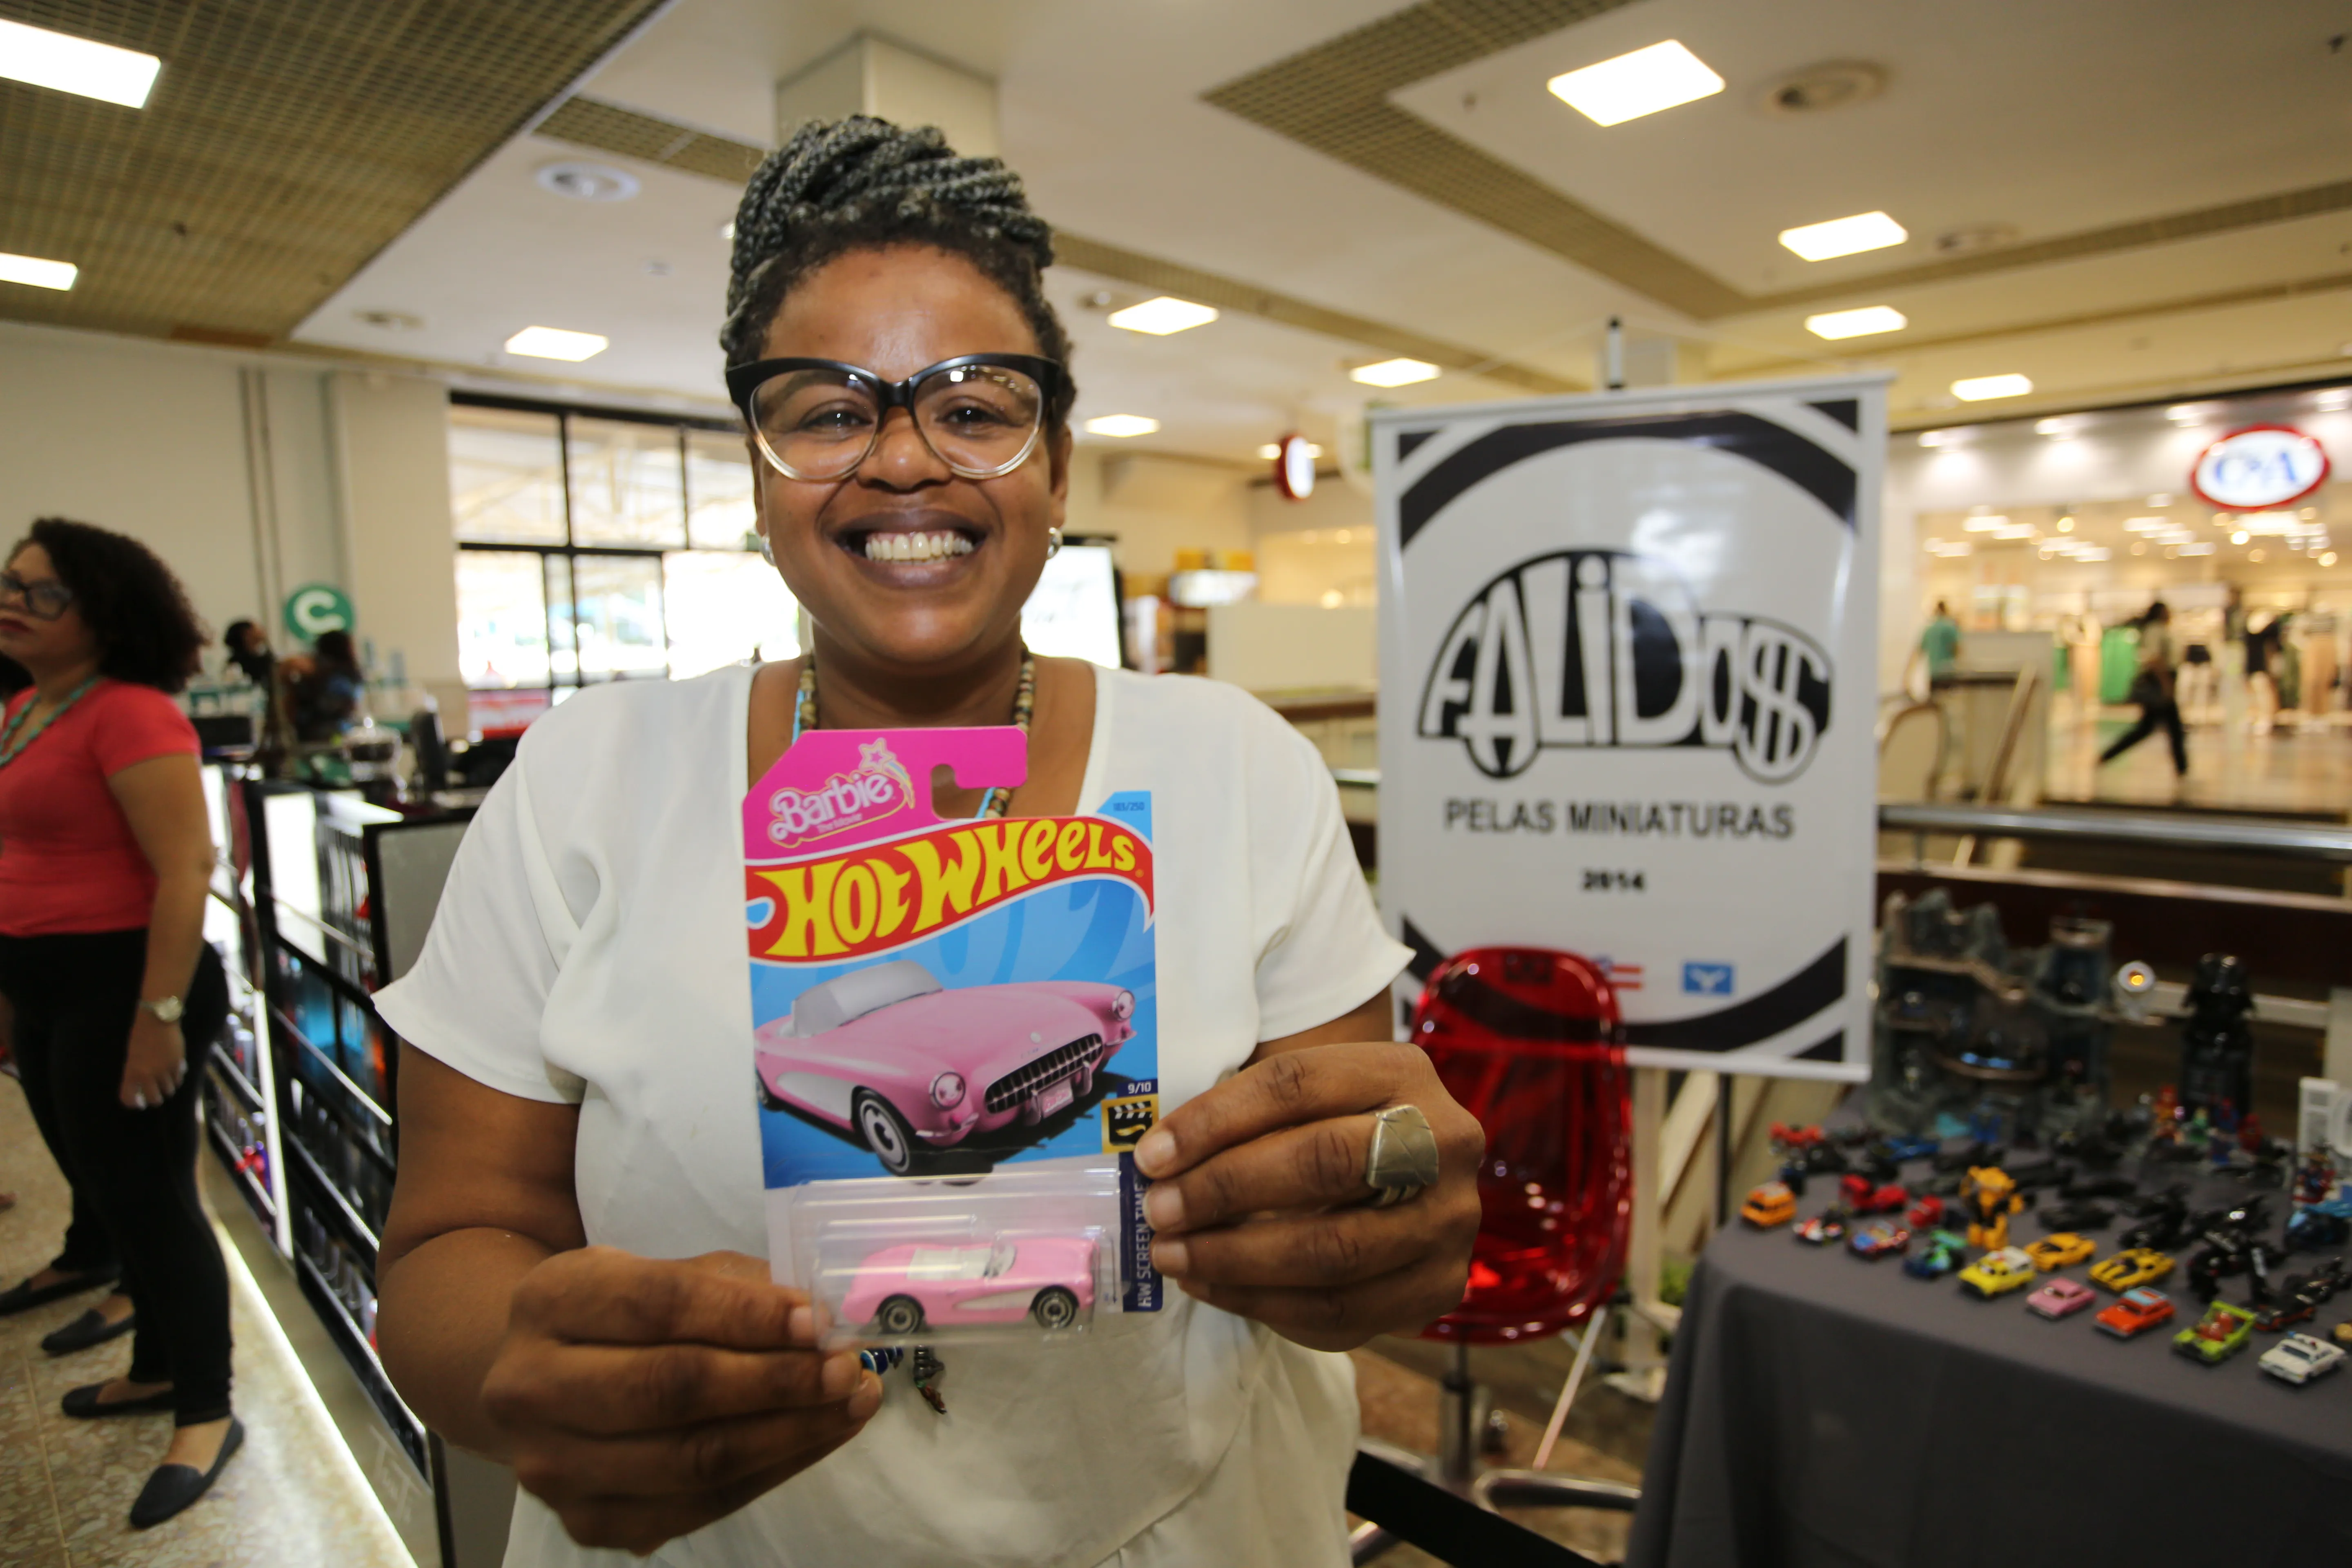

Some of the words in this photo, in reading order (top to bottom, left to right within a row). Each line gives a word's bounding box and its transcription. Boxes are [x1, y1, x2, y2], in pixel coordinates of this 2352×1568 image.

[771, 773, 893, 840] Barbie
[1446, 798, 1555, 834] PELAS
[1567, 802, 1795, 839] MINIATURAS
[1128, 1081, 1151, 1094] 9/10
[1136, 1223, 1151, 1279] SCREEN
[1138, 1283, 1152, 1307] HW
